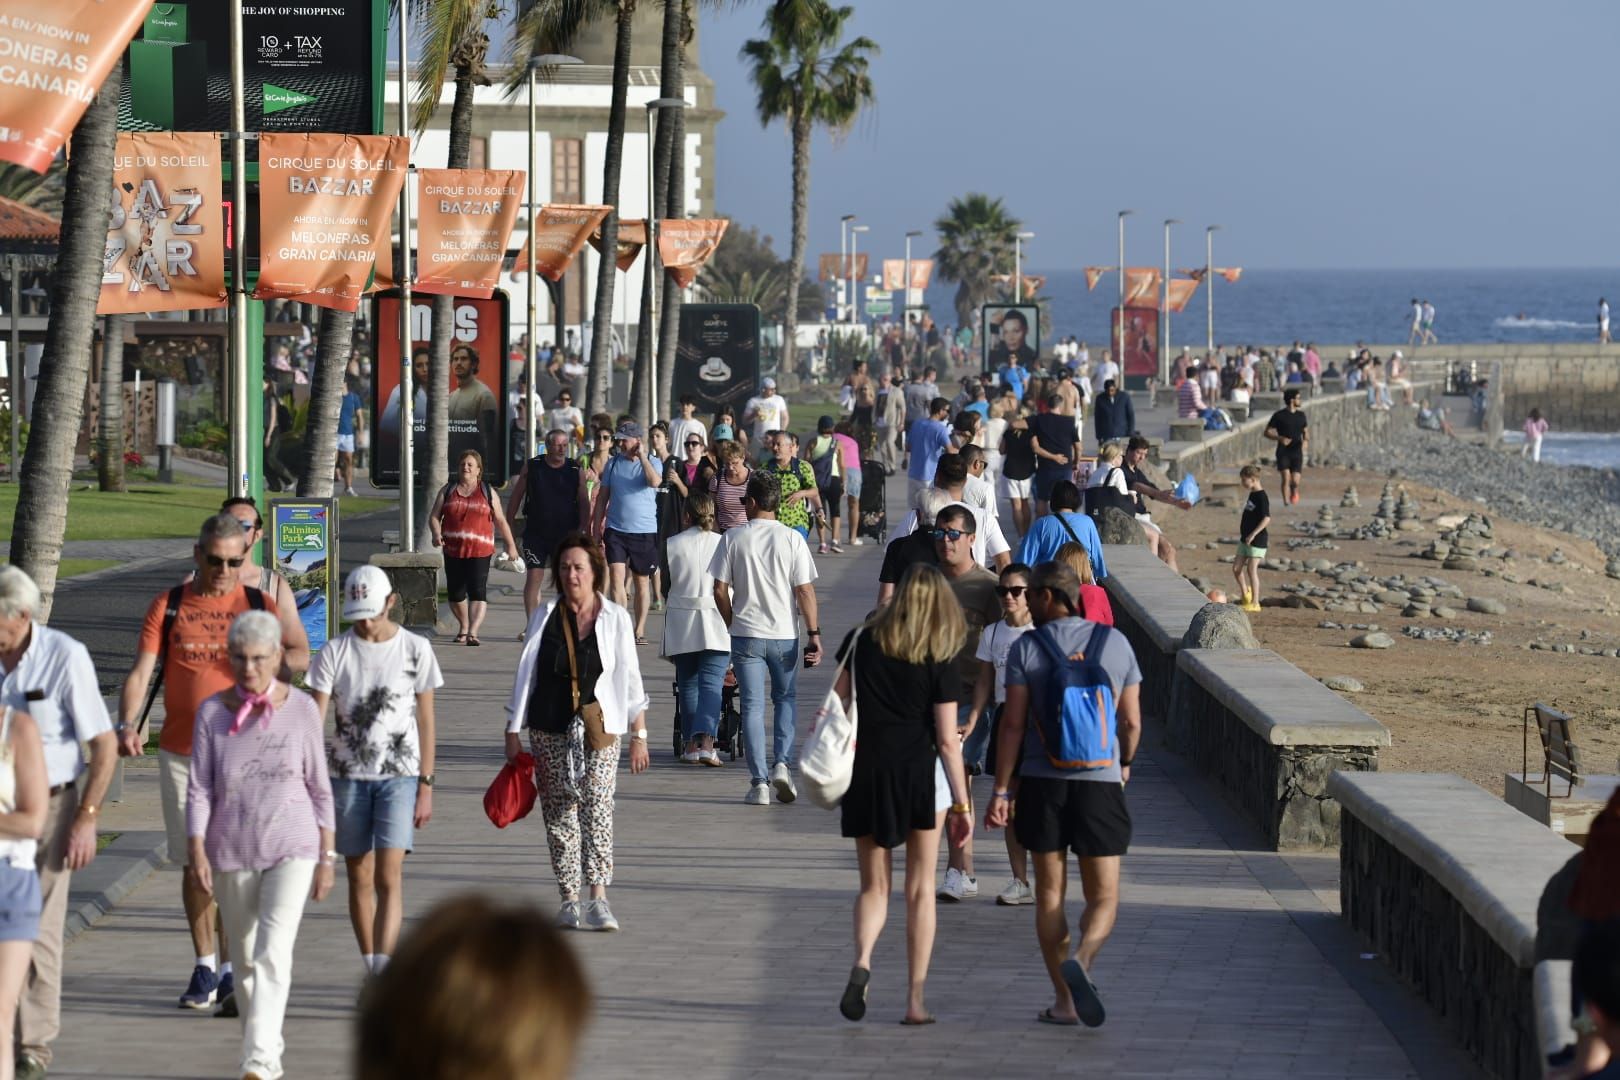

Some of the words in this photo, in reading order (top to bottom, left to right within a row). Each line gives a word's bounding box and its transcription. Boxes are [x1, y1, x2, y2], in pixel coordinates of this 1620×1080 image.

[242, 7, 256, 15] HE
[258, 7, 277, 15] JOY
[278, 7, 292, 15] OF
[293, 8, 345, 16] SHOPPING
[75, 33, 90, 44] IN
[294, 36, 322, 49] TAX
[114, 156, 132, 170] UE
[137, 156, 156, 167] DU
[160, 156, 209, 167] SOLEIL
[268, 158, 323, 171] CIRQUE
[327, 158, 346, 169] DU
[350, 159, 397, 171] SOLEIL
[289, 176, 375, 196] BAZZAR
[425, 186, 464, 197] CIRQUE
[467, 187, 481, 195] DU
[484, 187, 517, 196] SOLEIL
[440, 200, 502, 215] BAZZAR
[294, 216, 323, 224] AHORA
[291, 231, 370, 245] MELONERAS
[440, 240, 500, 250] MELONERAS
[279, 248, 316, 261] GRAN
[320, 250, 376, 262] CANARIA
[432, 253, 461, 263] GRAN
[448, 425, 480, 433] ttitude.
[282, 525, 321, 535] Palmitos
[282, 534, 304, 543] Park
